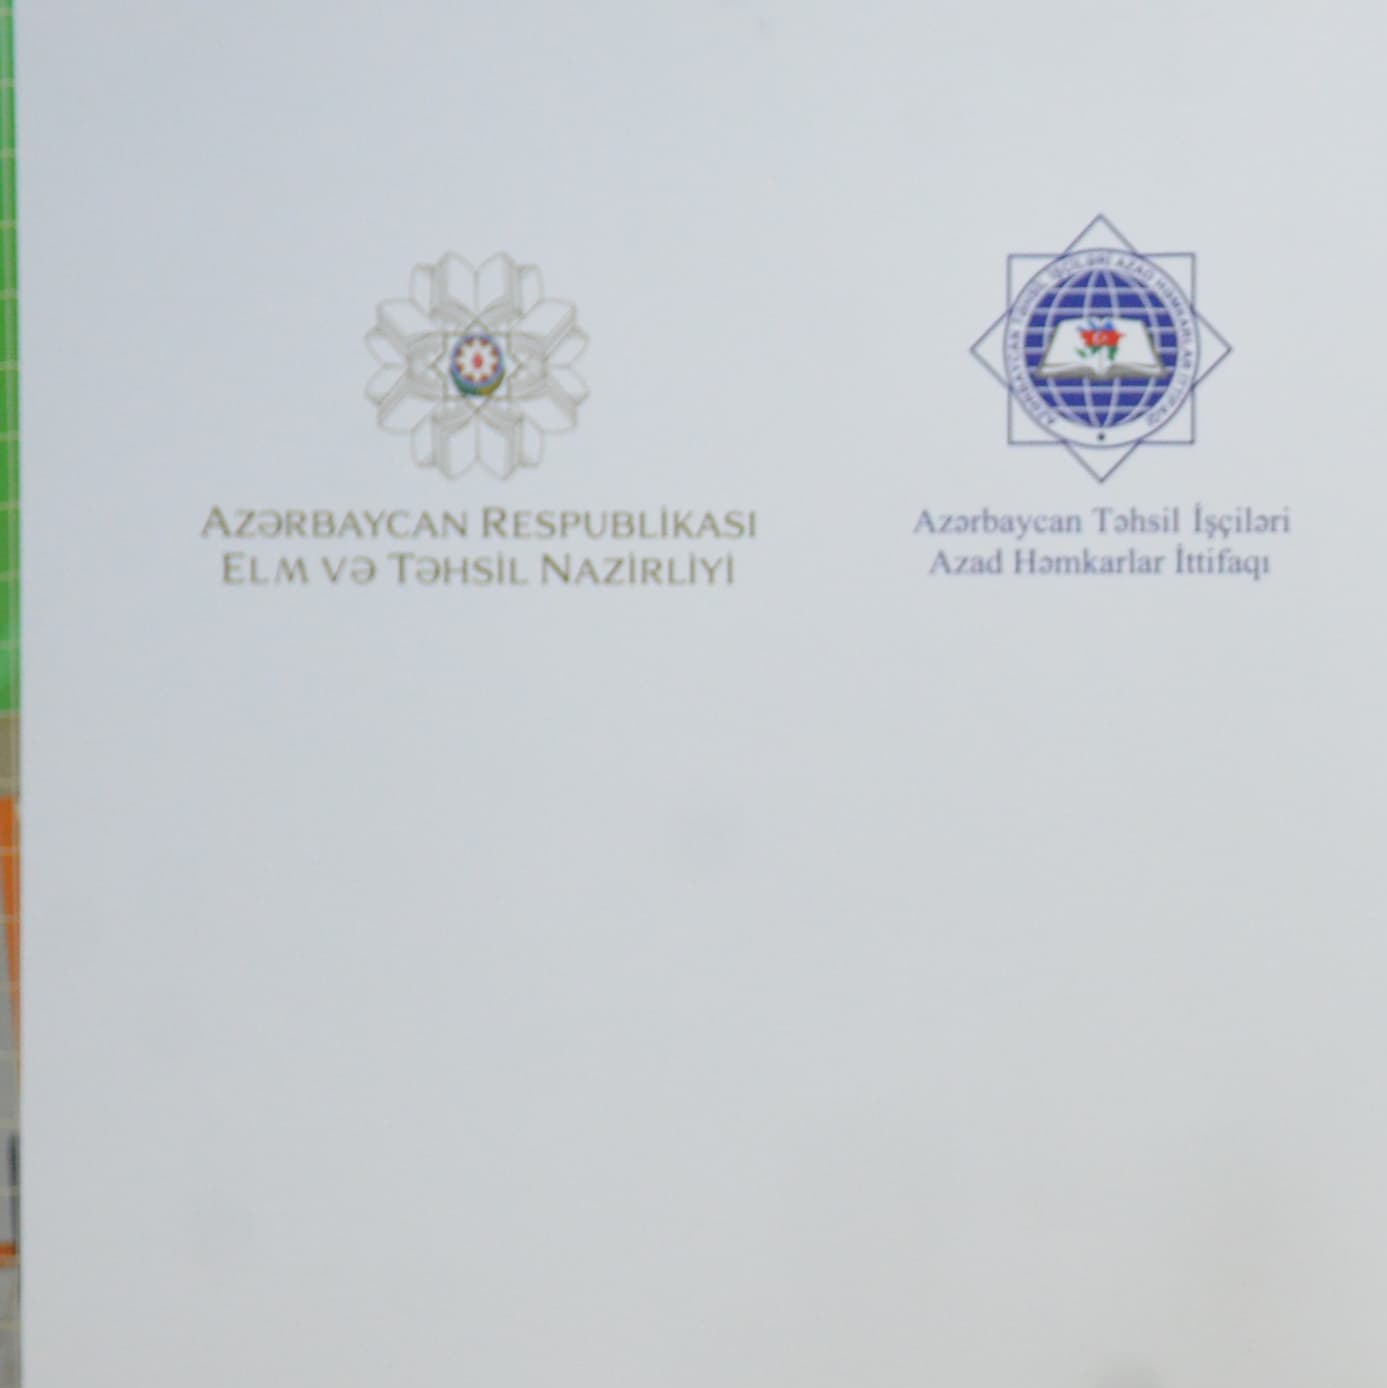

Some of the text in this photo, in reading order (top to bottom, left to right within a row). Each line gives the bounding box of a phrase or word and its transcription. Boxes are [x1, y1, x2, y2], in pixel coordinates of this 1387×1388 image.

[200, 504, 757, 539] AZƏRBAYCAN RESPUBLİKASI
[913, 501, 1291, 541] Azərbaycan Təhsil İşçiləri
[222, 550, 735, 586] ELM VƏ TƏHSİL NAZİRLİYİ
[929, 547, 1003, 576] Azad
[1013, 547, 1165, 576] Həmkarlar
